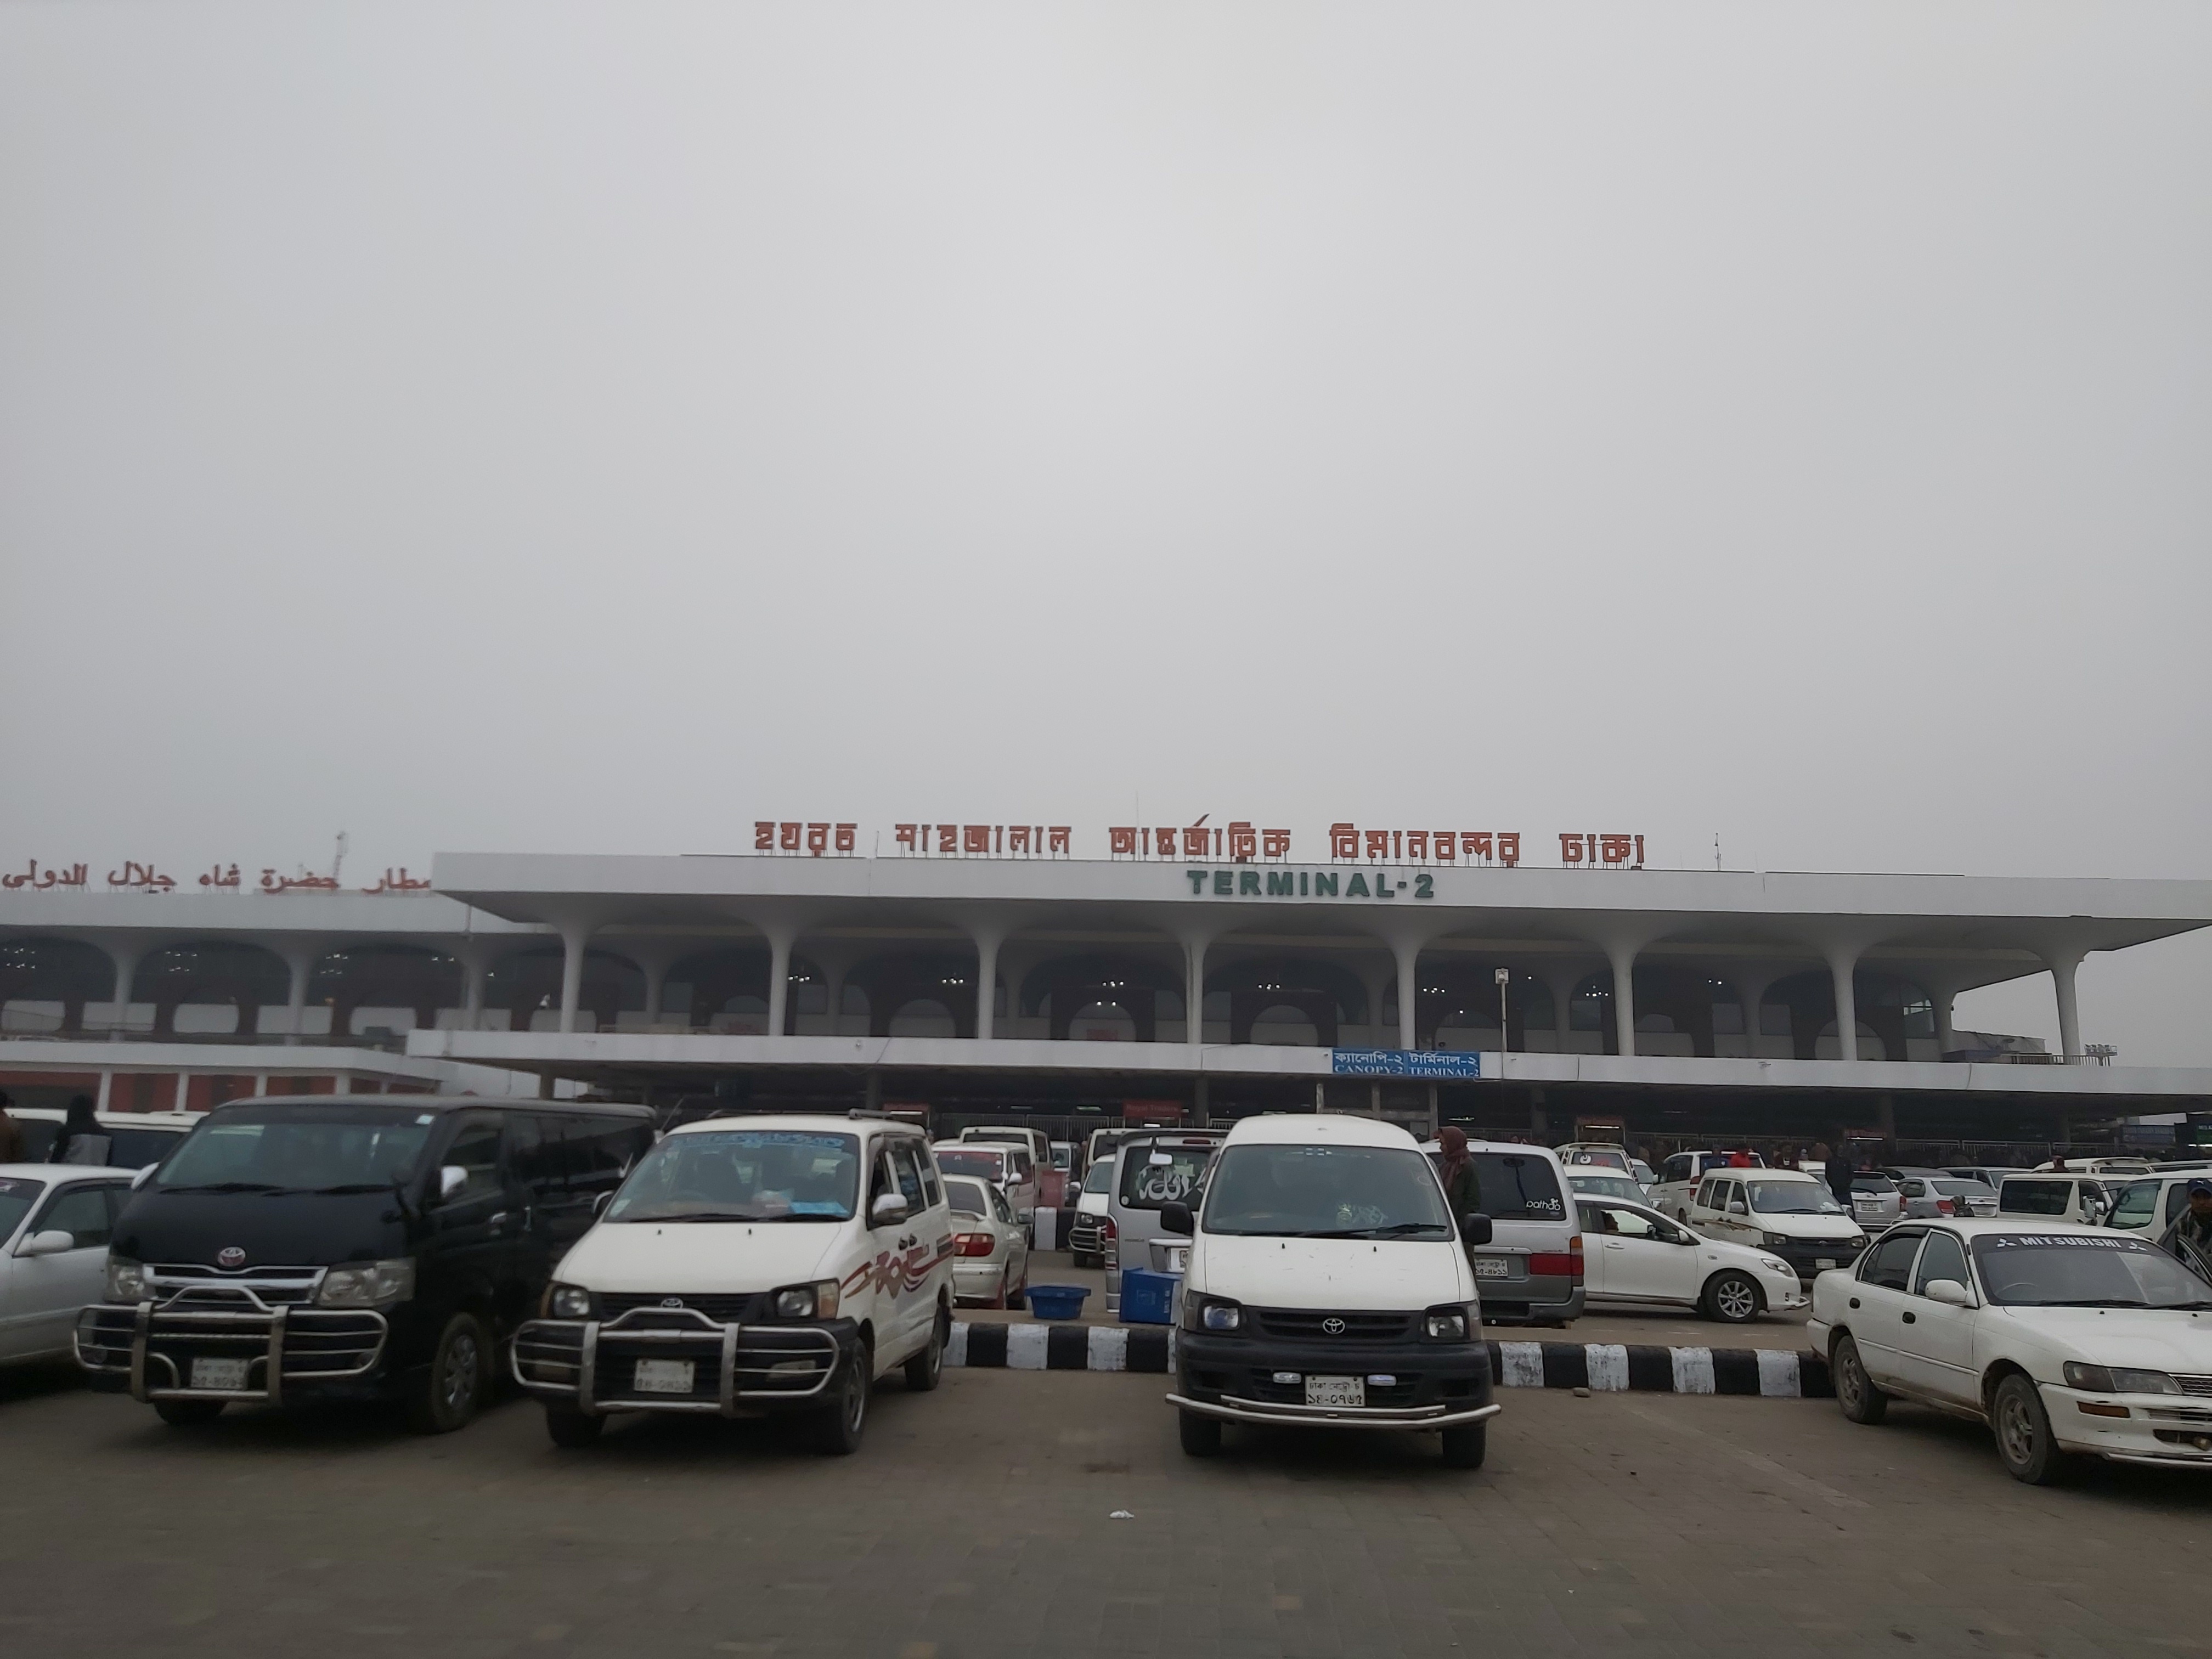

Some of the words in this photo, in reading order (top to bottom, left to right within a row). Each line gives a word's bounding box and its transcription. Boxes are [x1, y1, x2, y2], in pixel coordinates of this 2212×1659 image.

[755, 821, 858, 857] হযরত
[895, 824, 1071, 854] শাহজালাল
[1109, 814, 1290, 857] আন্তর্জাতিক
[1329, 823, 1520, 867] বিমানবন্দর
[1559, 833, 1645, 862] ঢাকা
[108, 860, 177, 892] جلال
[199, 863, 240, 886] شاه
[262, 868, 339, 893] حضرة
[361, 867, 431, 894] مطار
[1187, 870, 1434, 898] TERMINAL-2
[1334, 1064, 1403, 1074] CANOPY-2
[1408, 1066, 1480, 1077] TERMINAL-2
[1408, 1052, 1479, 1067] টার্মিনাল-২
[1526, 1199, 1561, 1211] pathao
[2019, 1236, 2122, 1248] MITSUBISHI
